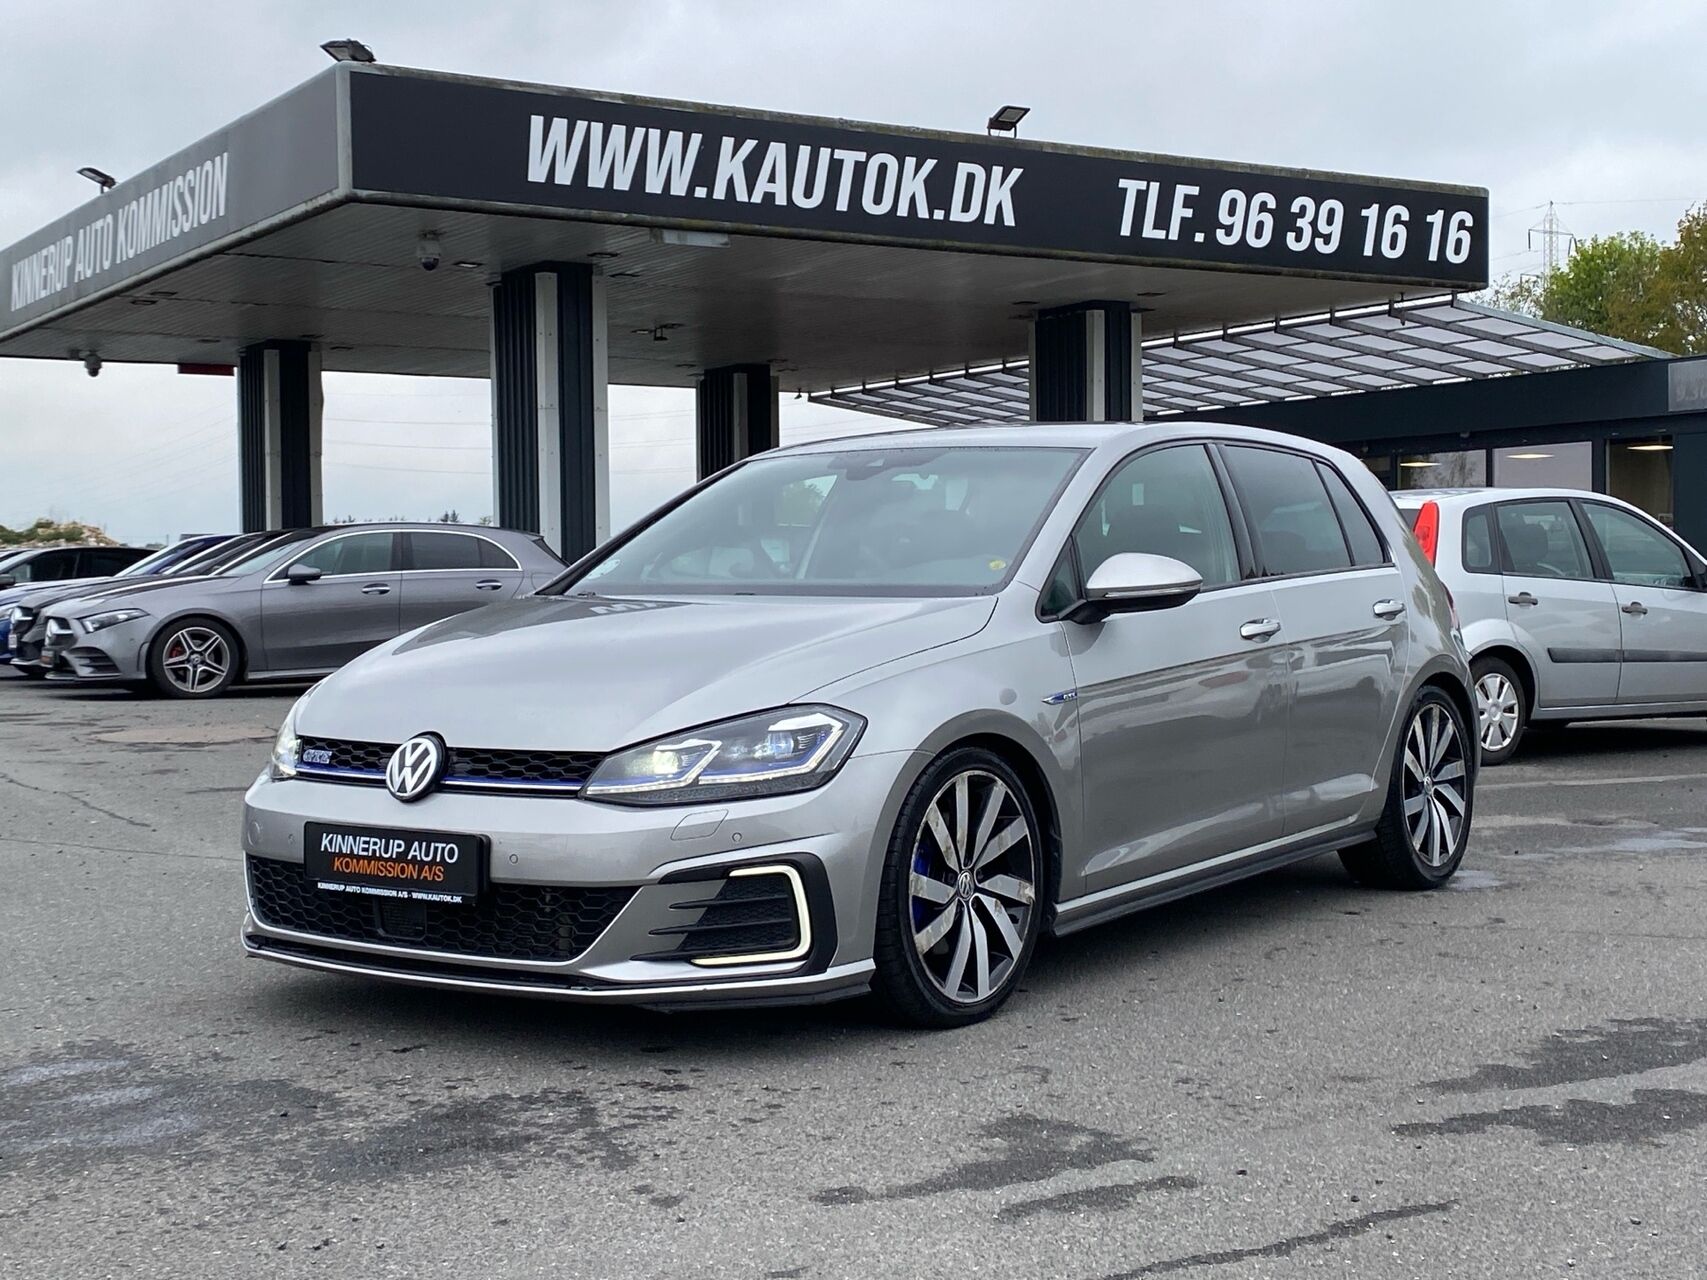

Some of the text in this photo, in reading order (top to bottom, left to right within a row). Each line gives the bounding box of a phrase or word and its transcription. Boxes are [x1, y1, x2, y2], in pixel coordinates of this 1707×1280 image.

[527, 115, 1024, 228] WWW.KAUTOK.DK
[11, 152, 229, 312] KINNERUP AUTO KOMMISSION
[1117, 178, 1474, 264] TLF. 96 39 16 16
[320, 832, 458, 863] KINNERUP AUTO
[333, 857, 444, 882] KOMMISSION A/S
[345, 885, 361, 893] AUTO
